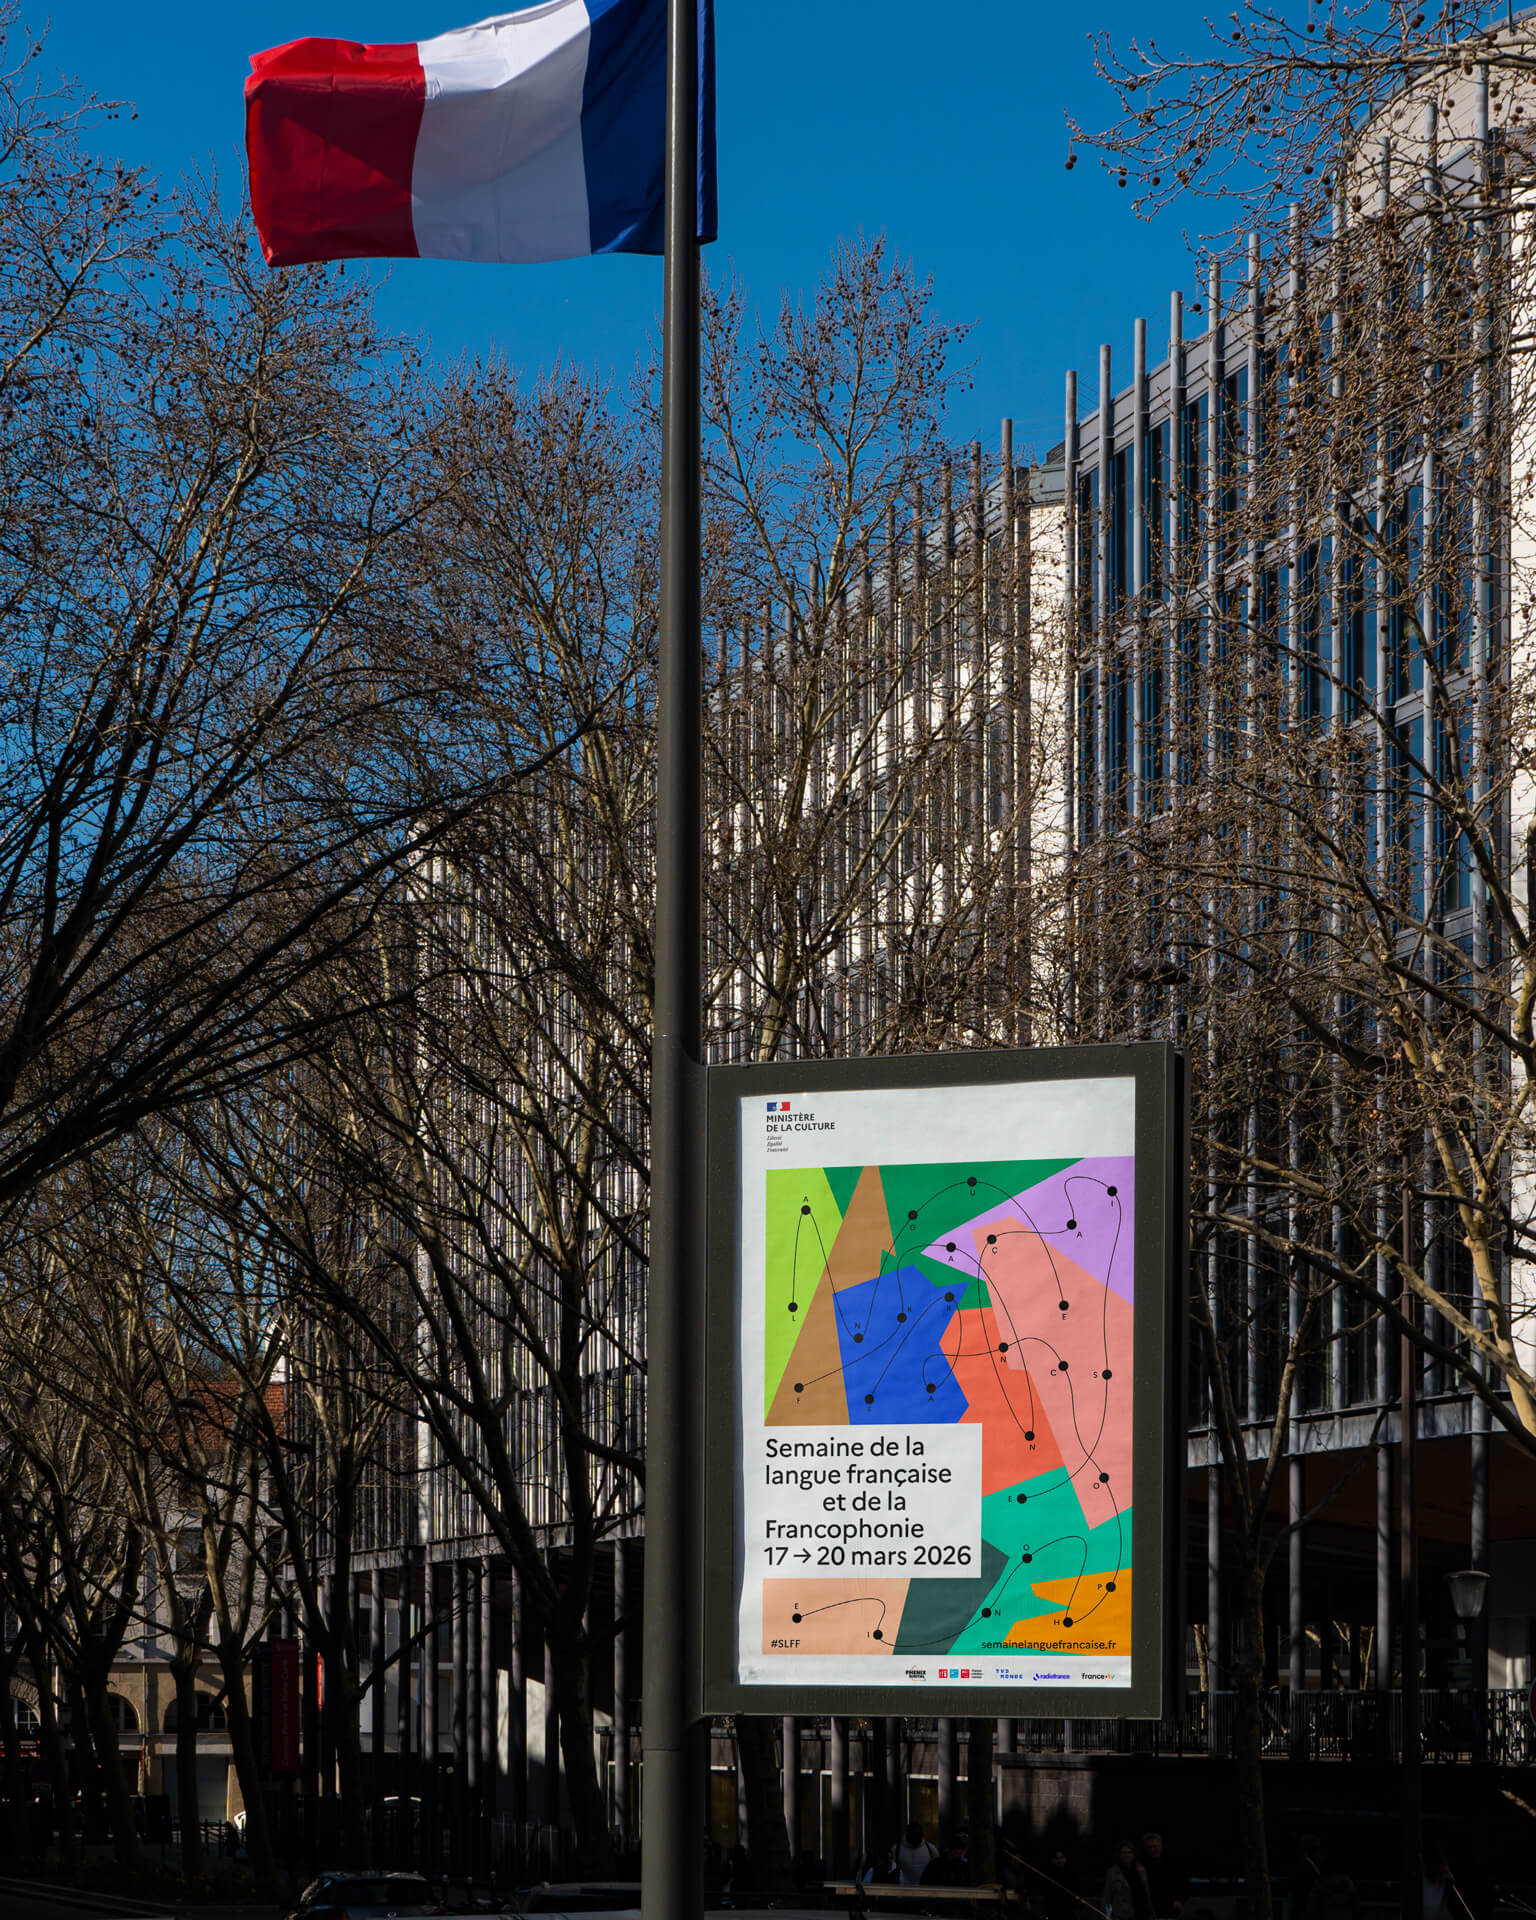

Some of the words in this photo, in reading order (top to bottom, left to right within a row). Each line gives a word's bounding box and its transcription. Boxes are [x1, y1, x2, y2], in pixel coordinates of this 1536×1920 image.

[766, 1112, 815, 1123] MINISTÈRE
[766, 1124, 778, 1132] DE
[794, 1122, 836, 1131] CULTURE
[992, 1246, 998, 1255] Ç
[766, 1436, 864, 1458] Semaine
[870, 1436, 900, 1456] de
[906, 1436, 924, 1456] la
[766, 1464, 841, 1490] langue
[846, 1462, 952, 1488] française
[822, 1494, 846, 1512] et
[852, 1491, 881, 1511] de
[888, 1490, 906, 1511] la
[766, 1518, 924, 1544] Francophonie
[764, 1546, 788, 1566] 17
[816, 1546, 845, 1566] 20
[851, 1548, 908, 1566] mars
[913, 1546, 972, 1566] 2026
[771, 1640, 800, 1648] #SLFF
[982, 1640, 1116, 1652] semainelanguefrancaise.fr
